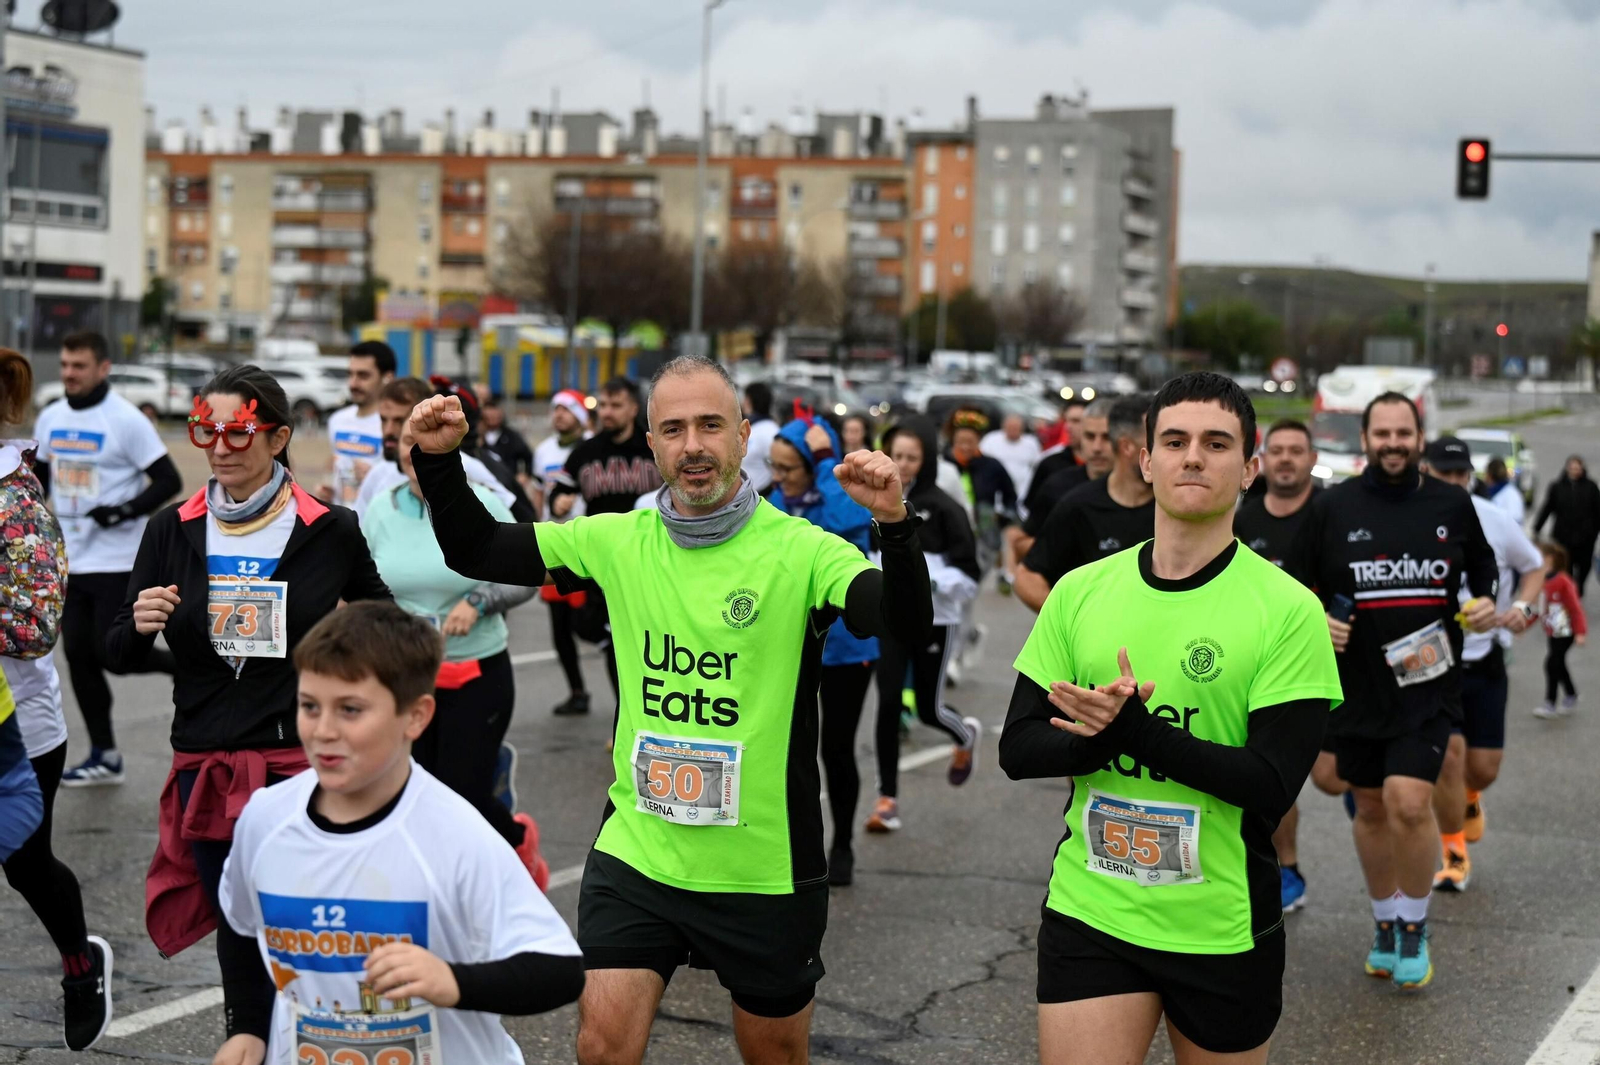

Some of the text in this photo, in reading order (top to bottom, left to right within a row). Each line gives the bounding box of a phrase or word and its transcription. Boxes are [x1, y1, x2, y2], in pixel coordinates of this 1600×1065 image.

[238, 560, 260, 575] 12
[208, 603, 258, 637] 73
[643, 630, 738, 680] Uber
[642, 676, 739, 727] Eats
[644, 743, 729, 758] CORDOBARIA
[673, 742, 691, 750] 12
[647, 759, 704, 803] 50
[644, 799, 675, 818] ILERNA
[1098, 803, 1187, 823] CORDOBARIA
[1129, 804, 1146, 813] 12
[1103, 820, 1162, 867] 55
[1098, 859, 1138, 878] ILERNA
[312, 905, 346, 928] 12
